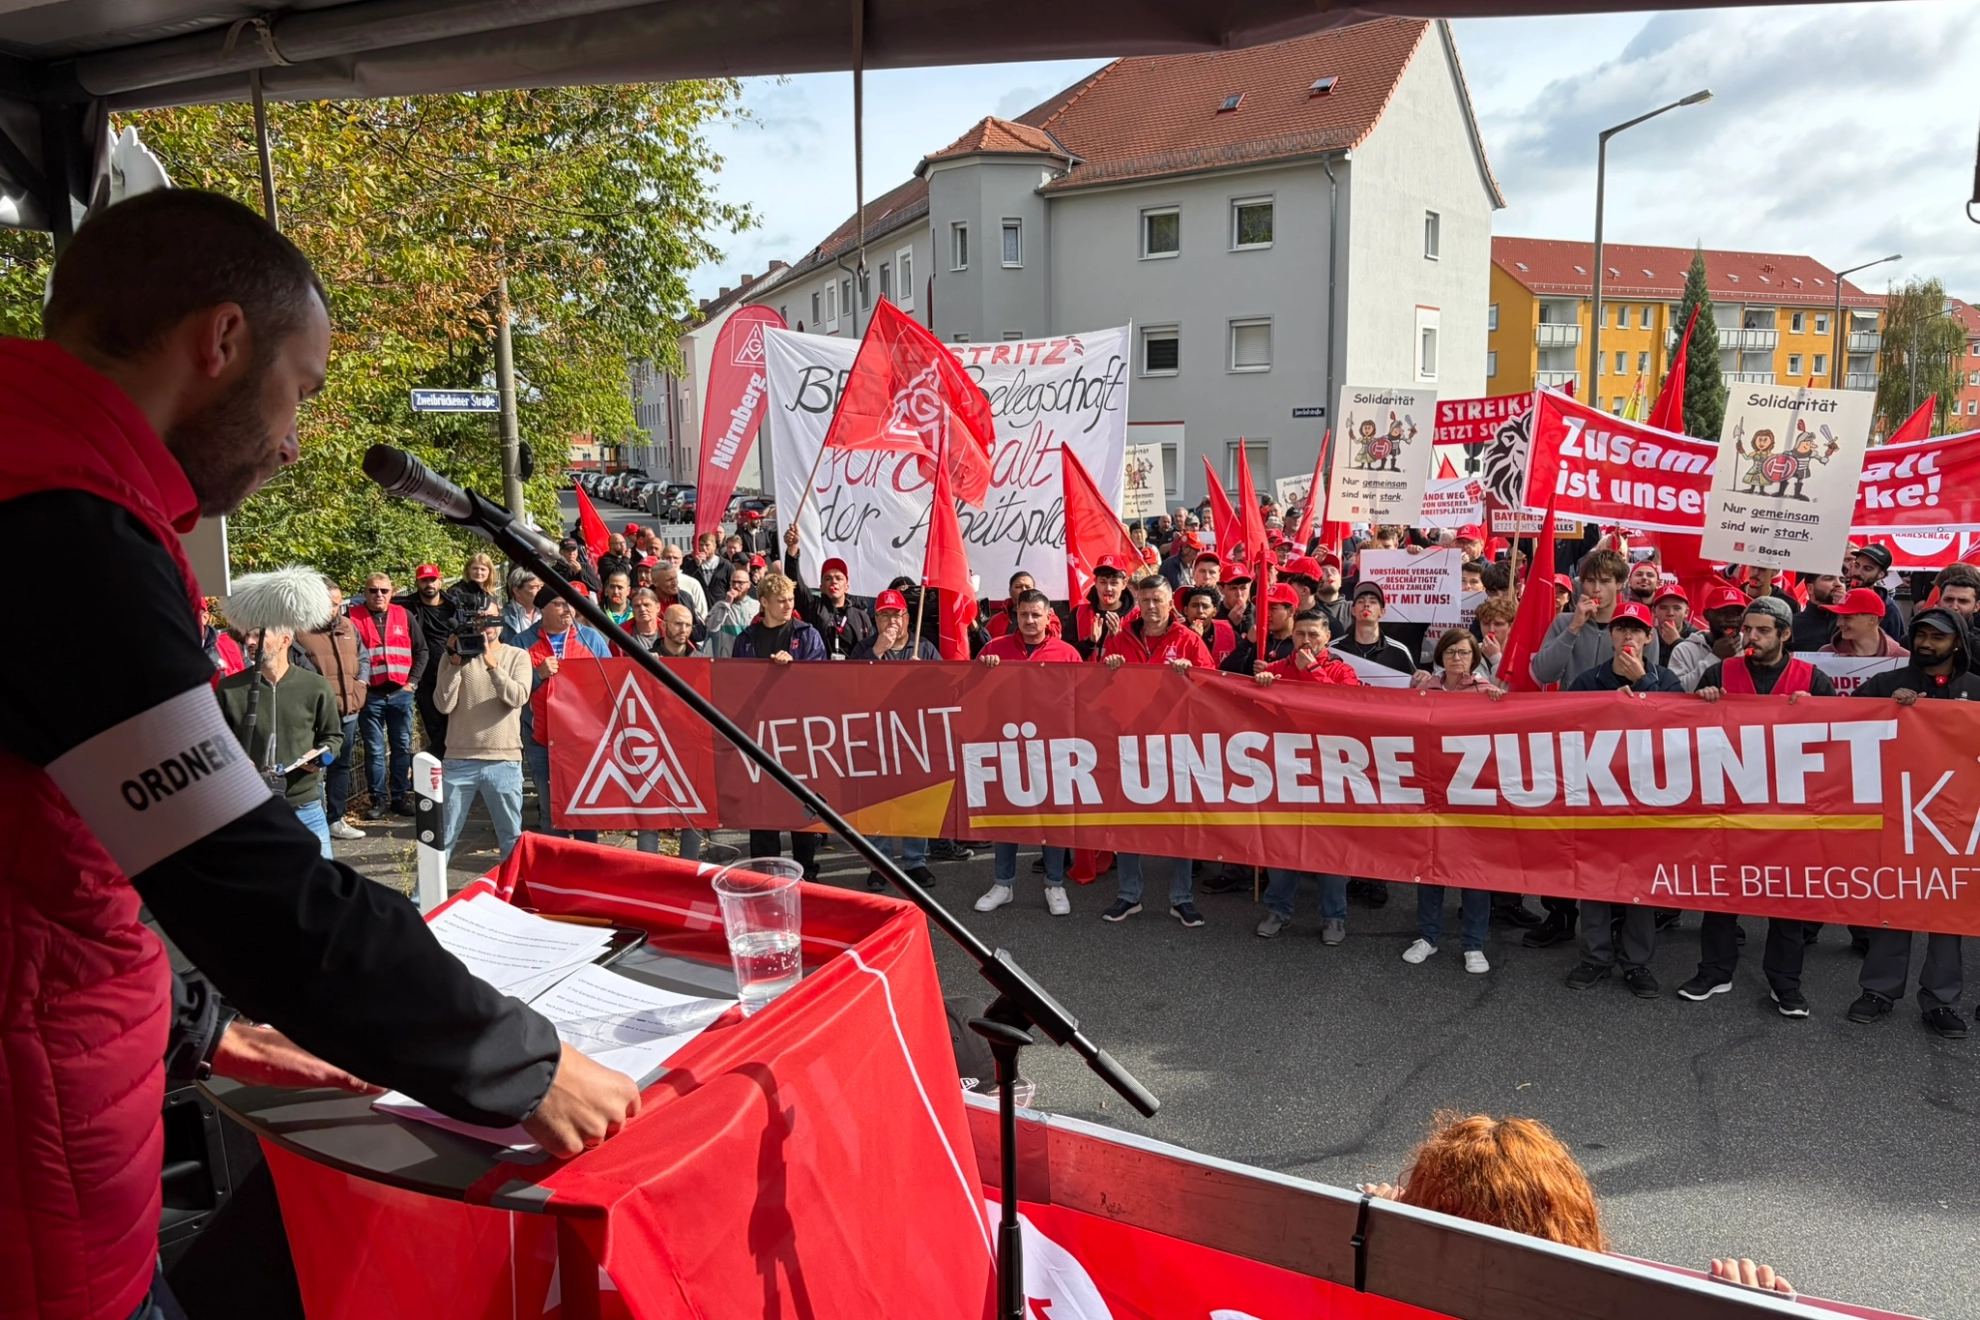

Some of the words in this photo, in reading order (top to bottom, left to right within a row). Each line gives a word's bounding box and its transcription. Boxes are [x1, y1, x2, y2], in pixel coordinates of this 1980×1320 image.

[416, 394, 470, 406] Zweibrückener
[471, 394, 495, 408] Straße
[1353, 394, 1415, 406] Solidarität
[1747, 394, 1838, 412] Solidarität
[710, 372, 767, 470] Nürnberg
[1342, 477, 1359, 486] Nur
[1362, 480, 1408, 488] gemeinsam
[1555, 460, 1602, 500] ist
[1342, 491, 1359, 499] sind
[1380, 493, 1404, 502] stark.
[1423, 492, 1444, 500] ÄNDE
[1447, 492, 1465, 500] WEG
[1421, 507, 1474, 515] RBEITSPLÄTZEN!
[1722, 502, 1747, 514] Nur
[1751, 508, 1820, 524] gemeinsam
[1494, 522, 1512, 531] JETZT
[1720, 520, 1745, 532] sind
[1750, 525, 1770, 535] wir
[1774, 528, 1813, 542] stark.
[1758, 546, 1791, 557] Bosch
[1370, 567, 1410, 575] VORSTÄNDE
[1411, 568, 1450, 576] VERSAGEN,
[1386, 575, 1437, 583] BESCHÄFTIGTE
[1401, 594, 1421, 604] MIT
[1424, 594, 1450, 605] UNS!
[736, 706, 962, 784] VEREINT
[962, 721, 1104, 808] FÜR
[1118, 731, 1425, 805] UNSERE
[1441, 718, 1898, 808] ZUKUNFT
[120, 734, 238, 812] ORDNER
[1650, 863, 1728, 896] ALLE
